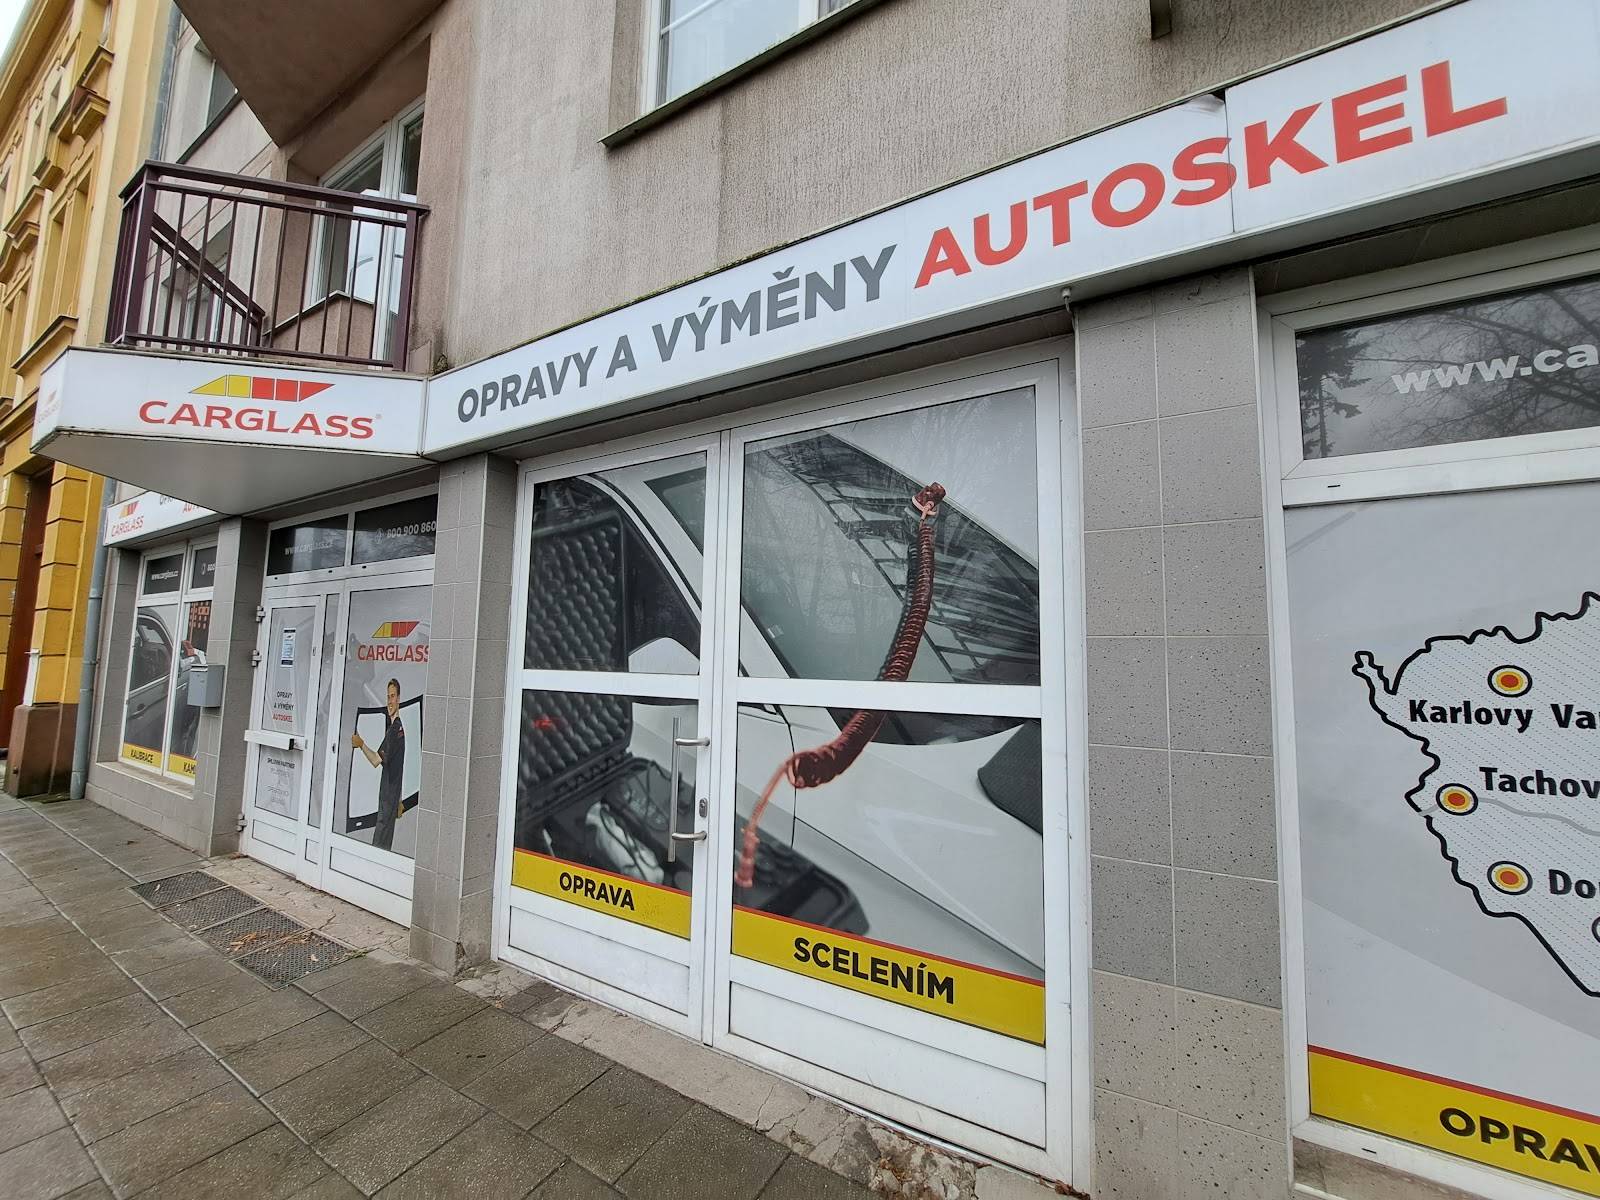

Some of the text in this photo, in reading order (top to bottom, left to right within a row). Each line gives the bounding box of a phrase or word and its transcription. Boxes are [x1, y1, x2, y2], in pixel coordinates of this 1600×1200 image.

[457, 60, 1508, 424] OPRAVY A VÝMĚNY AUTOSKEL
[403, 525, 419, 537] 900
[1409, 699, 1600, 734] Karlovy Va
[1479, 766, 1600, 799] Tachov
[558, 871, 635, 911] OPRAVA
[1549, 868, 1600, 899] Do
[793, 936, 954, 1005] SCELENÍM
